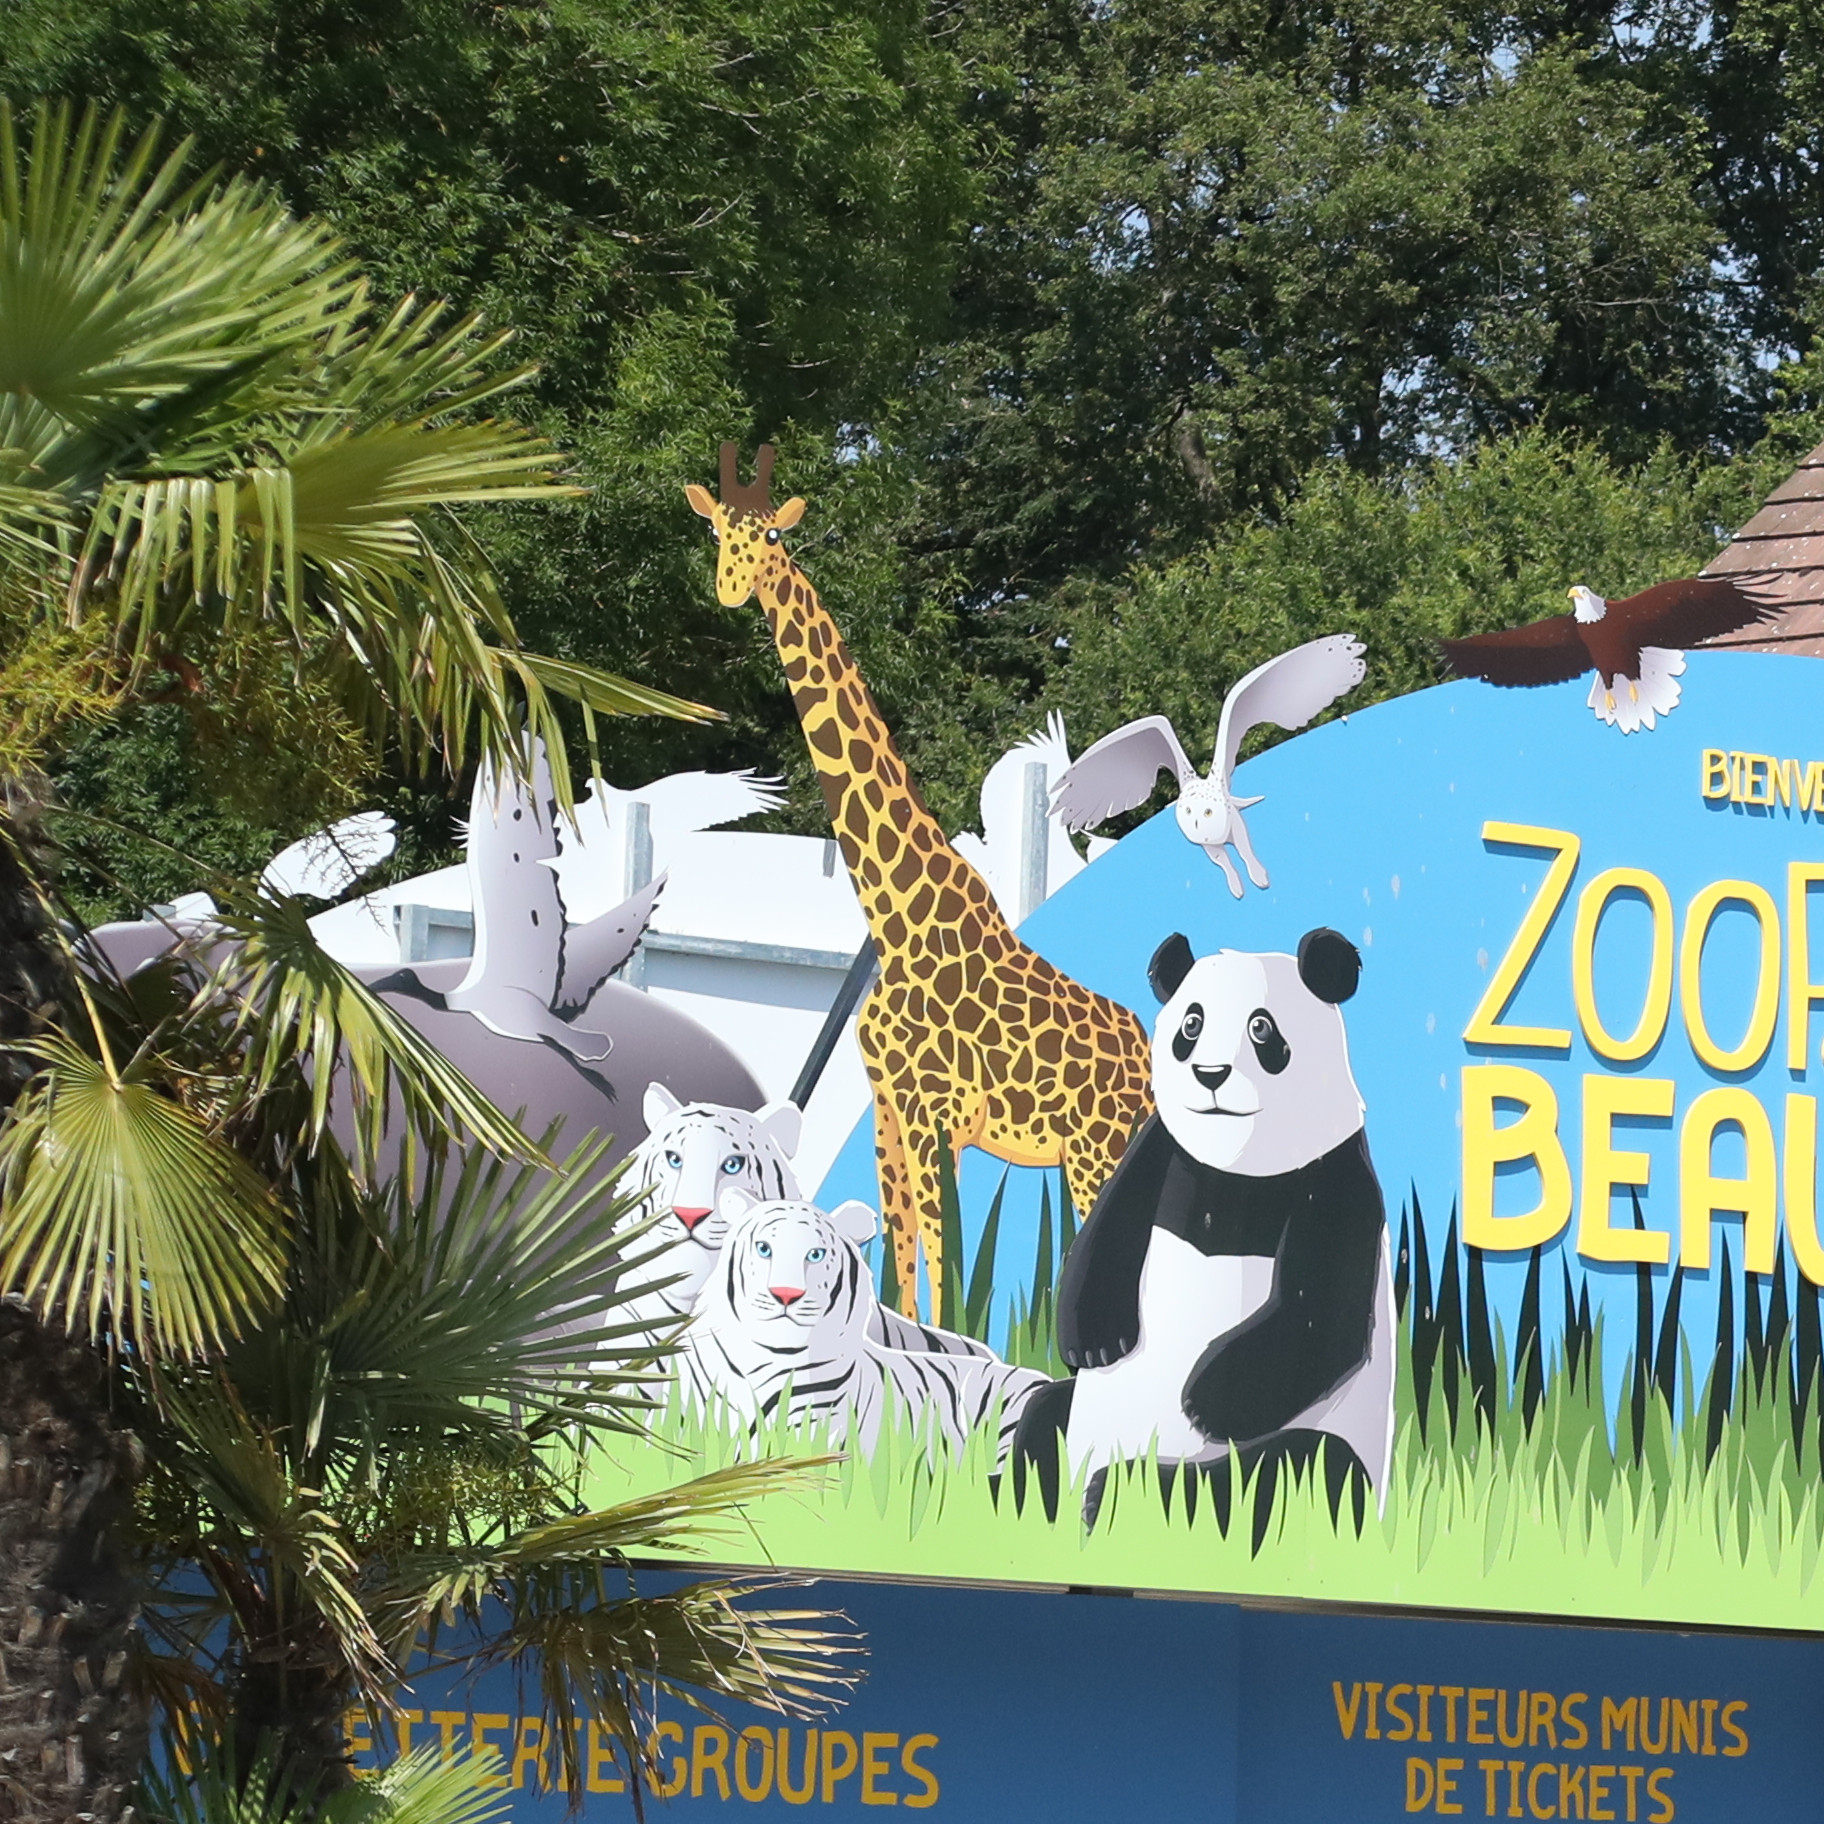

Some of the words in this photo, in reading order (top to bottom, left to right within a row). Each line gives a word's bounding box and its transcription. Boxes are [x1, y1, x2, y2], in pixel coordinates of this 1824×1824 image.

[1332, 1681, 1588, 1750] VISITEURS
[1601, 1697, 1749, 1758] MUNIS
[645, 1719, 940, 1808] GROUPES
[1404, 1757, 1463, 1814] DE
[1479, 1760, 1676, 1824] TICKETS
